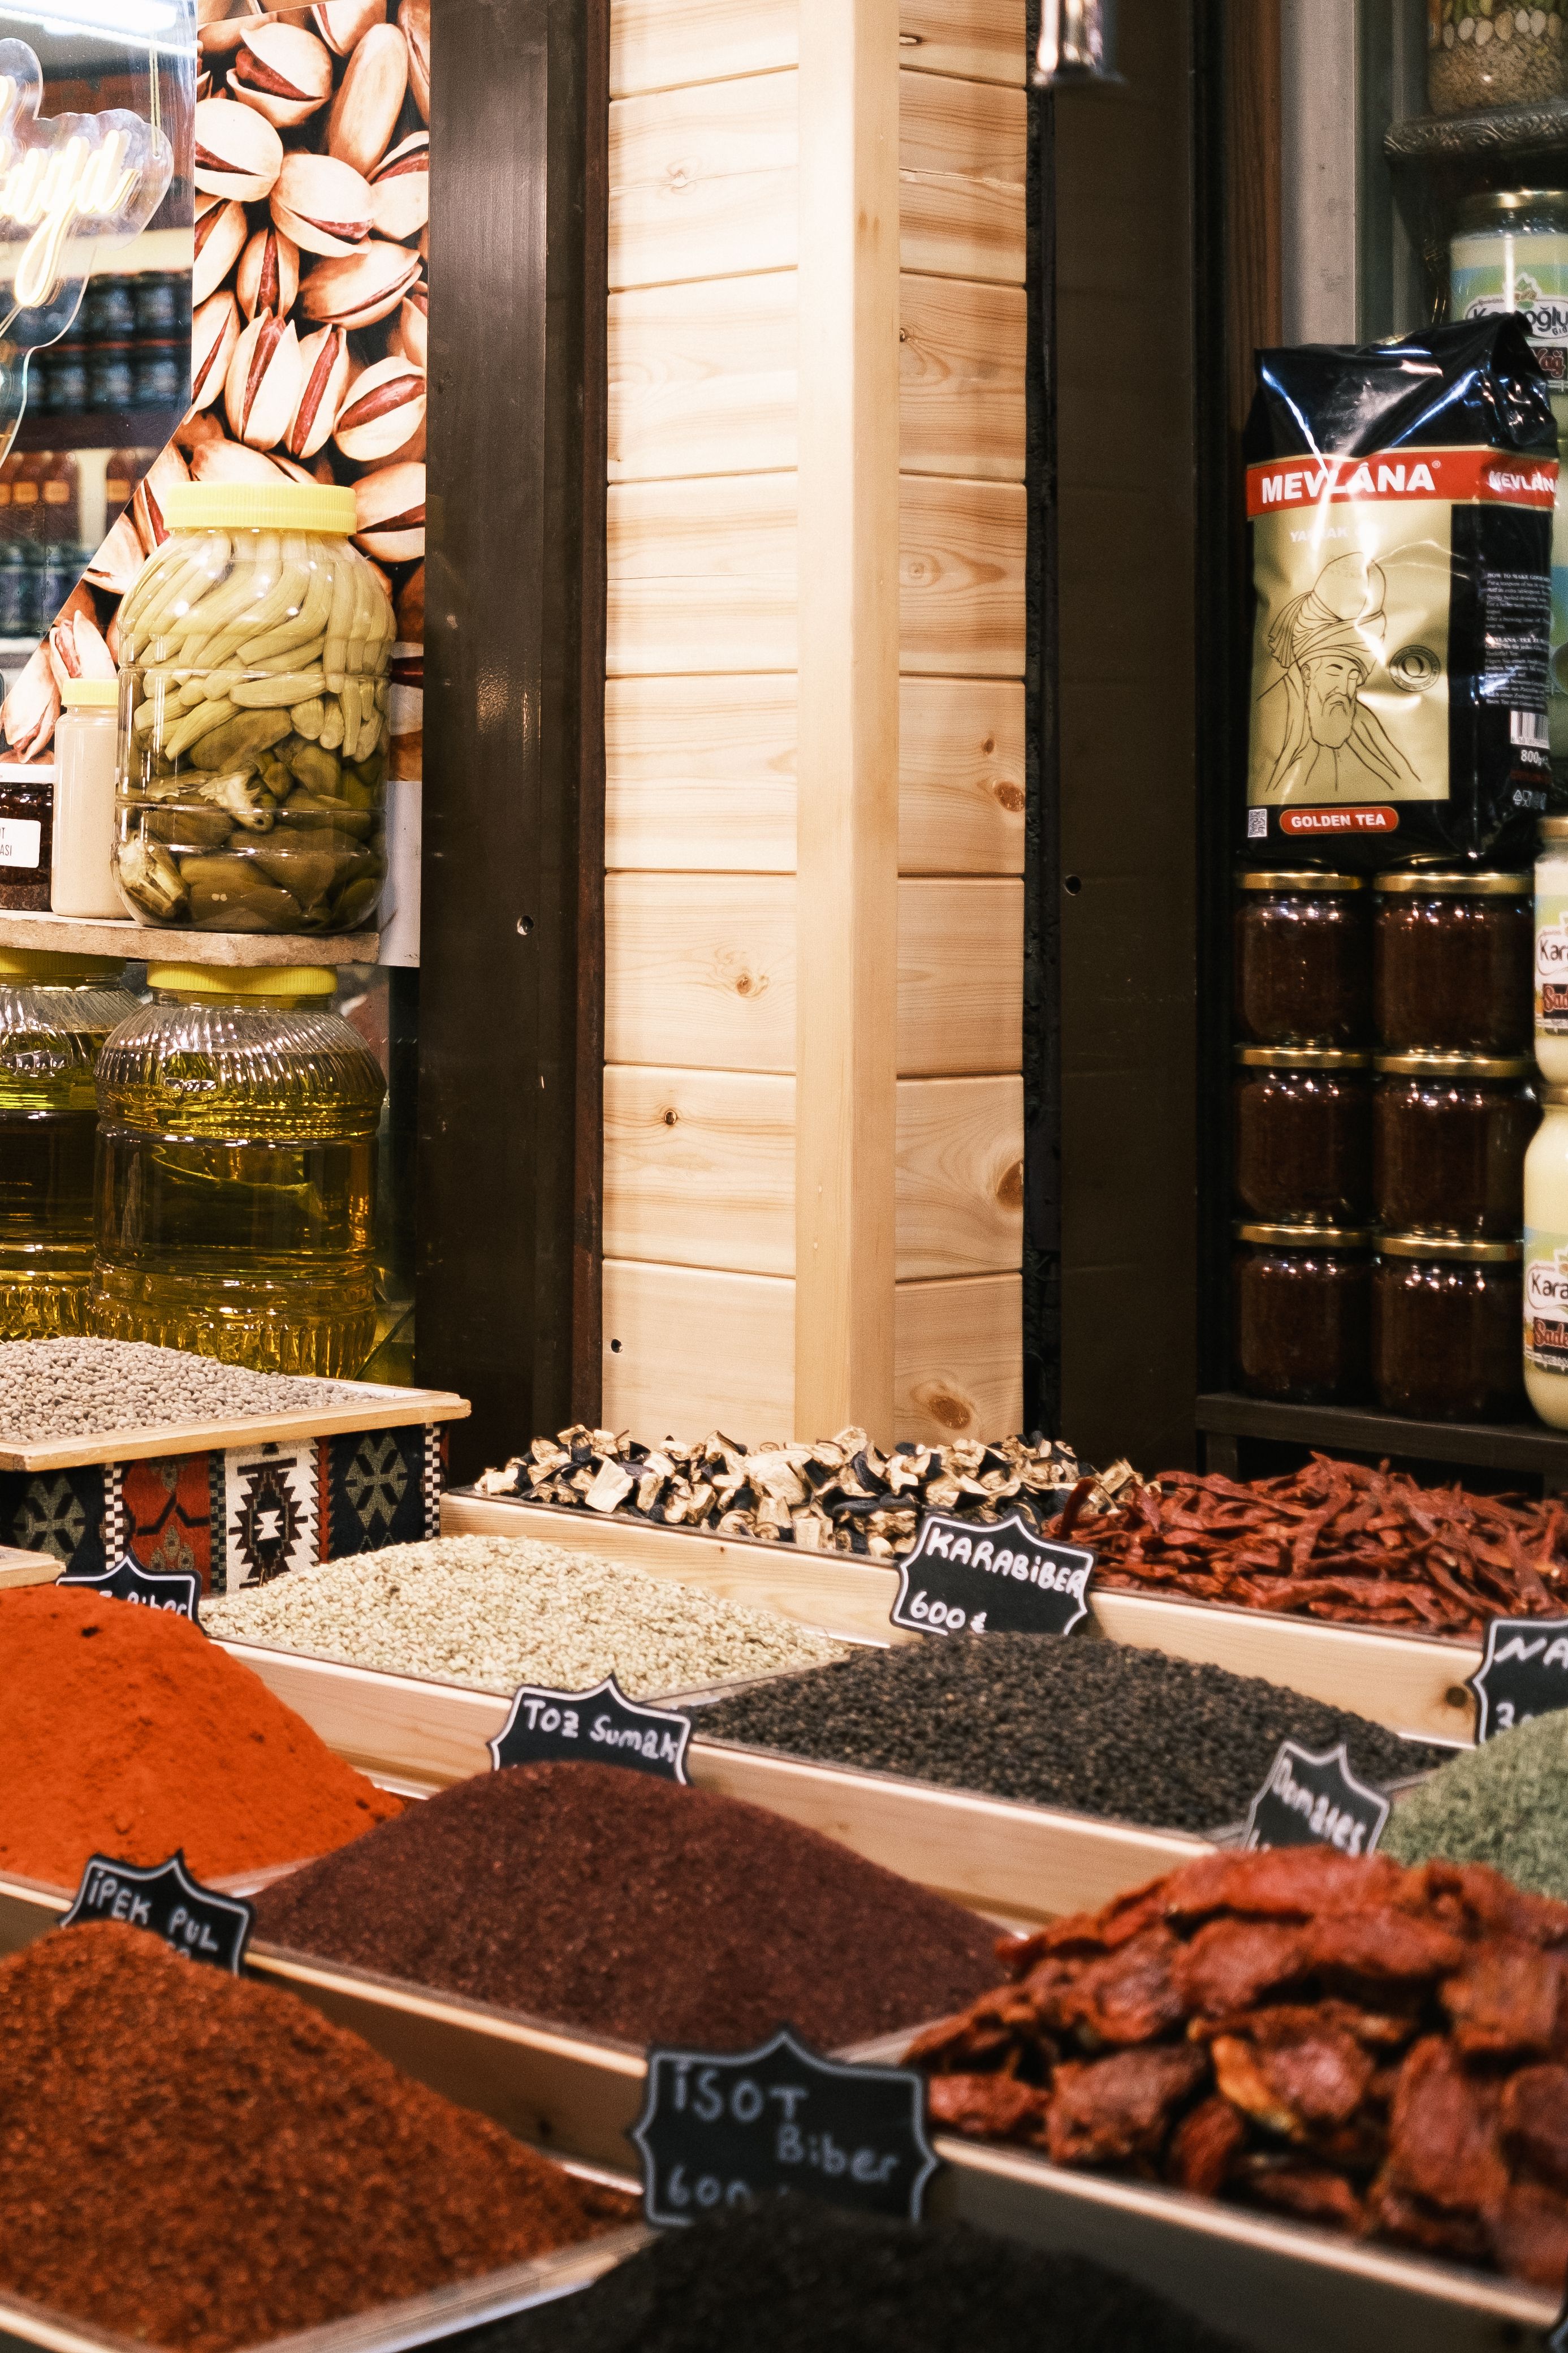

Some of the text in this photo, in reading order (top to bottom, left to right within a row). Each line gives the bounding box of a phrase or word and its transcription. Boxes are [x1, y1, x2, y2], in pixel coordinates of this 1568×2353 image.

[1291, 813, 1386, 828] GOLDEN TEA
[776, 2124, 900, 2183] Biber
